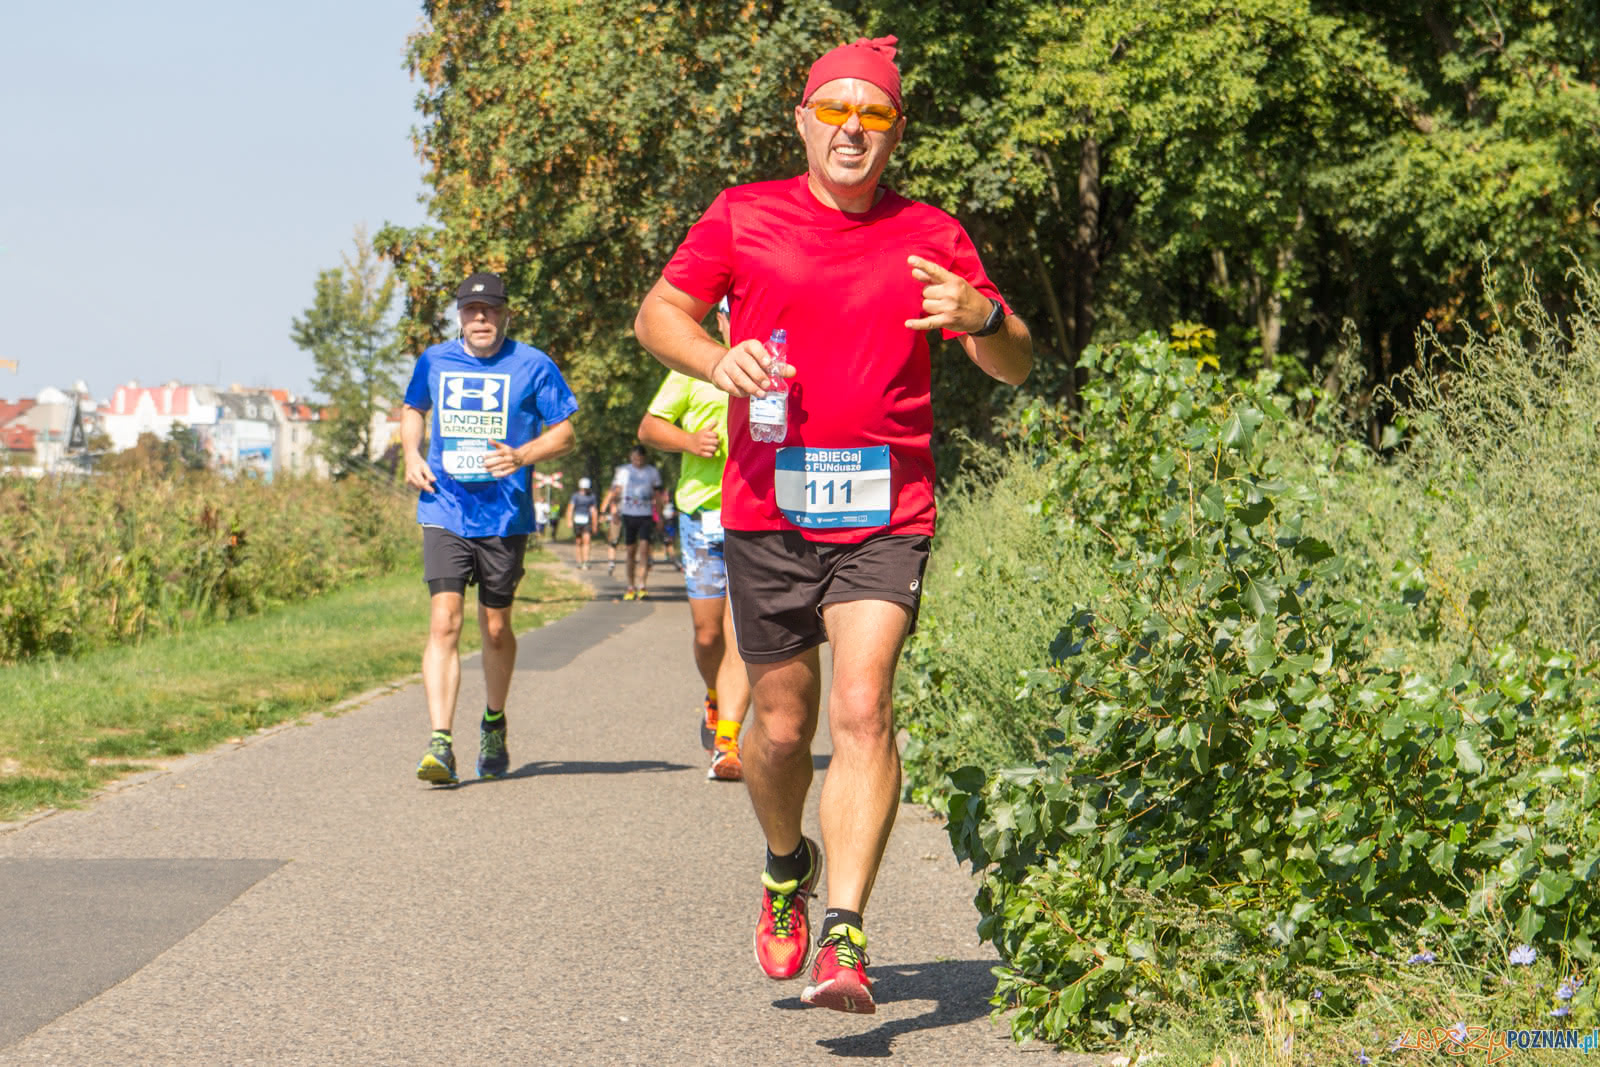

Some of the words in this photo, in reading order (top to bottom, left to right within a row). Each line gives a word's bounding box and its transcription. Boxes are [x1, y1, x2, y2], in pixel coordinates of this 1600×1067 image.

[442, 414, 503, 426] UNDER
[805, 451, 862, 463] zaBIEGaj
[813, 463, 862, 472] FUNdusze
[805, 480, 852, 505] 111
